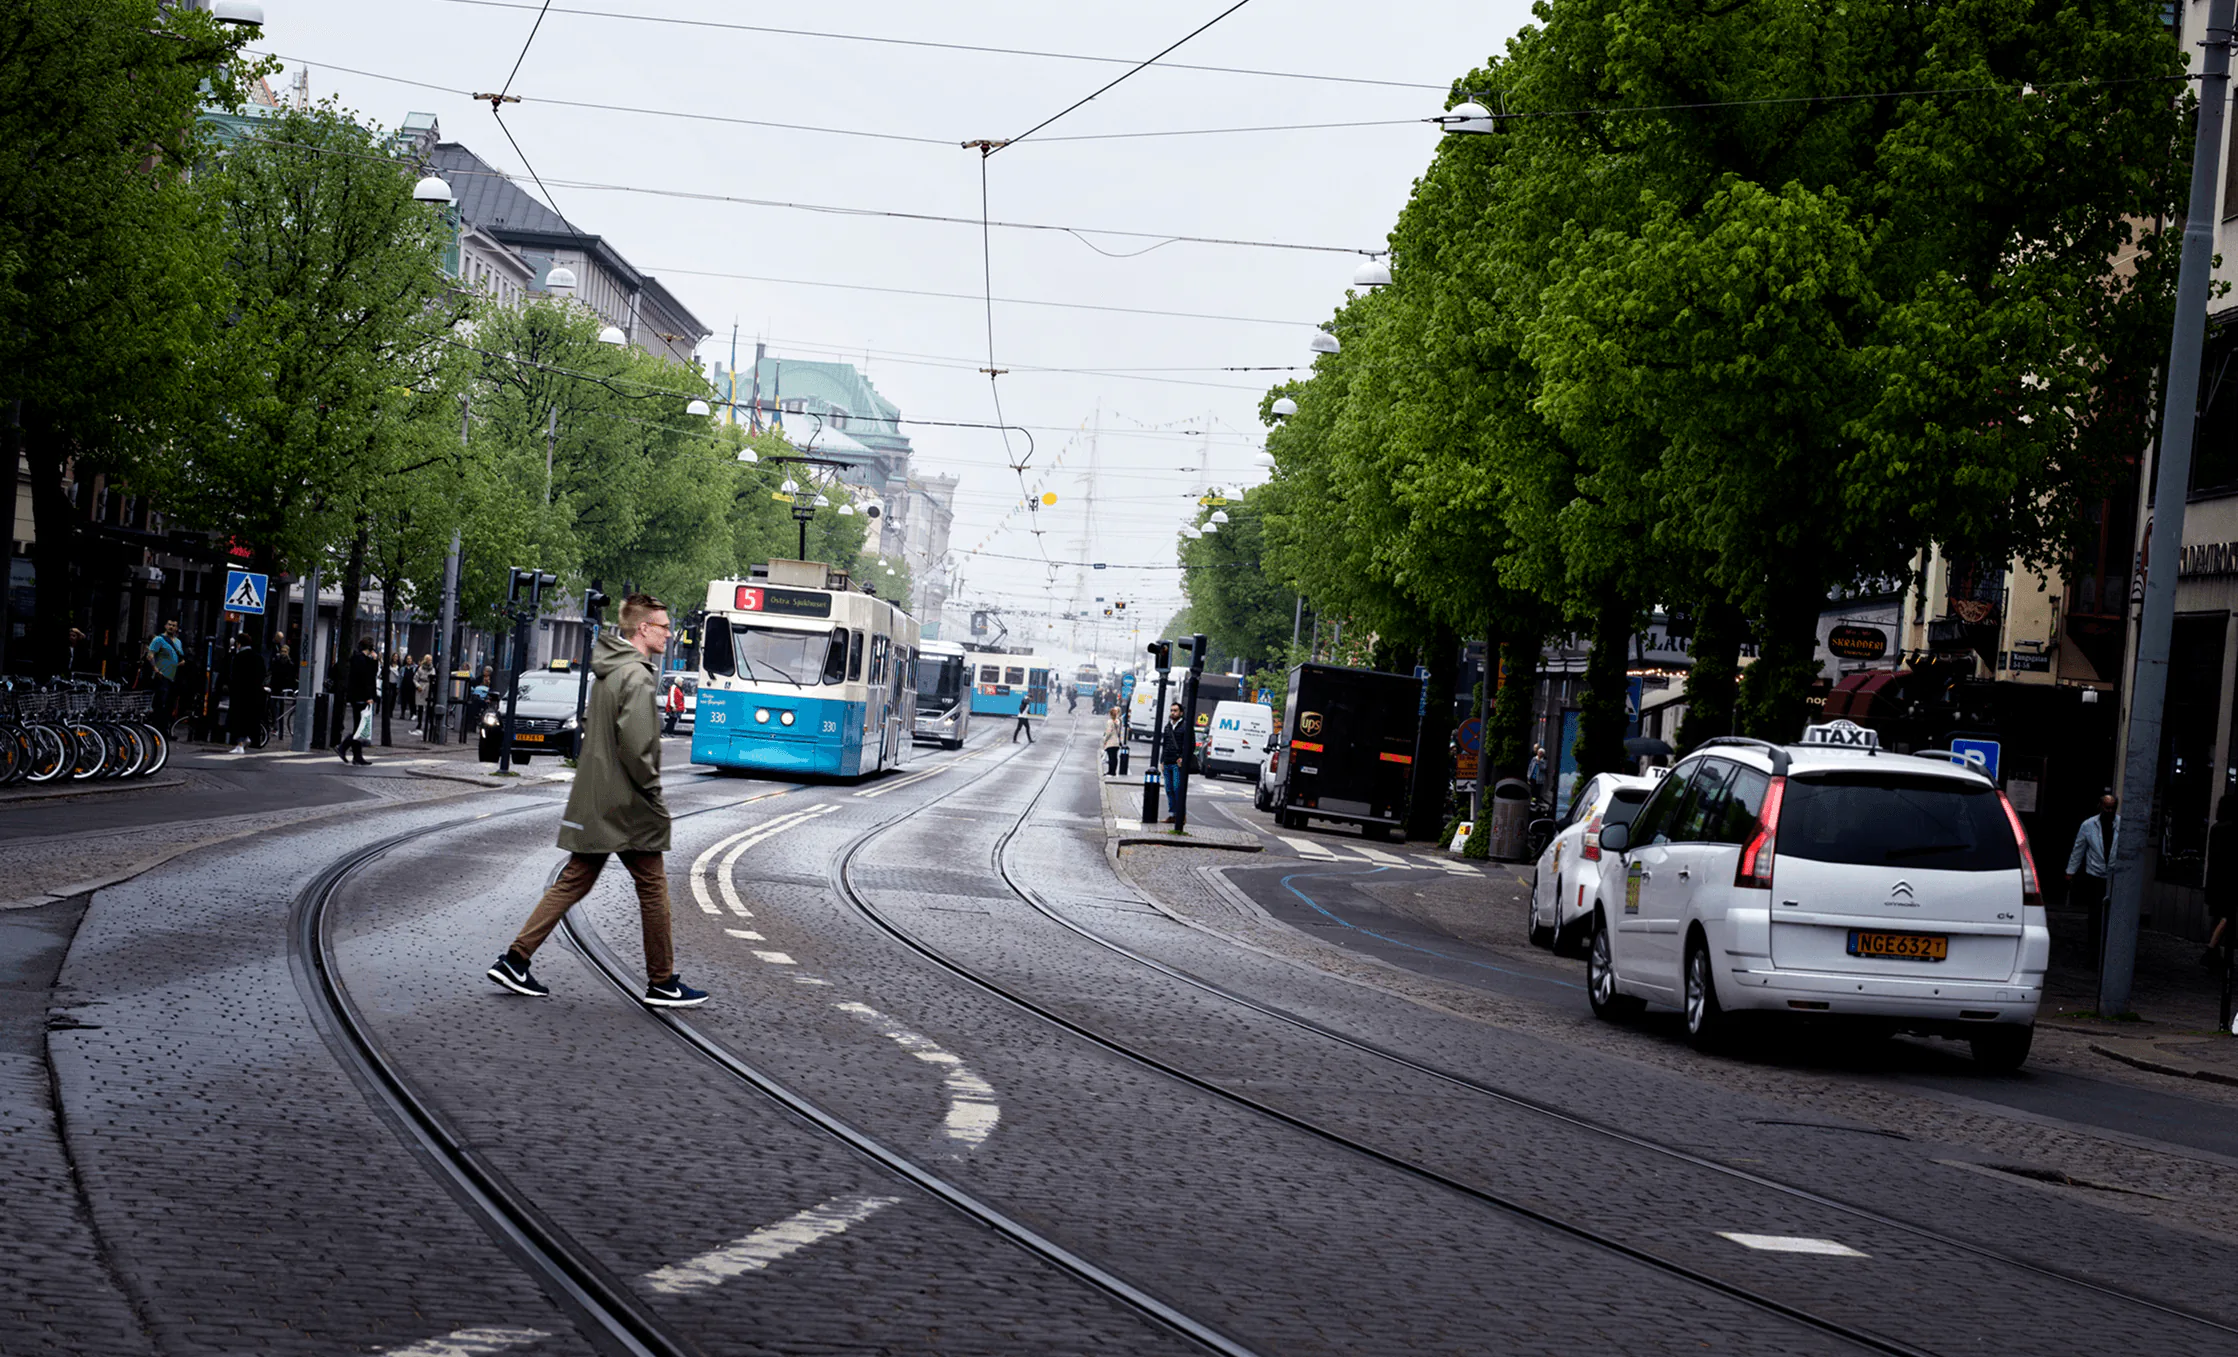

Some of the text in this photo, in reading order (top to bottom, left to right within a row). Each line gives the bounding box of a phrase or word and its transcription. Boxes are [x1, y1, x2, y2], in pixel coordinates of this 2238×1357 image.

[743, 589, 756, 609] 5
[709, 711, 727, 724] 330
[1219, 718, 1240, 731] MJ
[821, 720, 837, 733] 330
[1301, 718, 1322, 733] ups
[1815, 728, 1871, 746] TAXI
